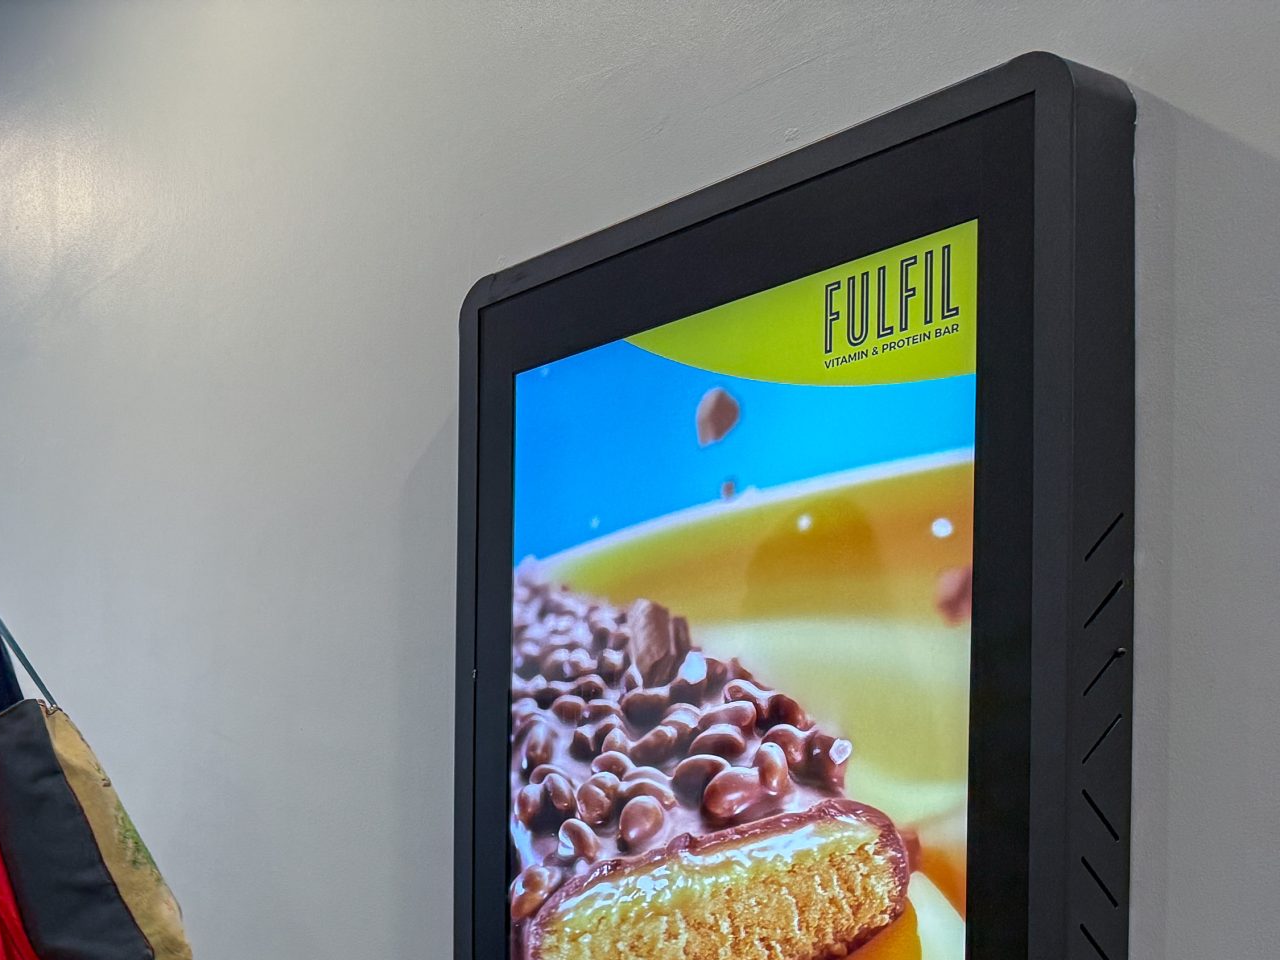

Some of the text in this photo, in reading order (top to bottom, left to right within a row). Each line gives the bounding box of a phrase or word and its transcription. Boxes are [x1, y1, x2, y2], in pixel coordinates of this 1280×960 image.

[824, 244, 960, 354] FULFIL
[824, 323, 960, 369] VITAMIN & PROTEIN BAR
